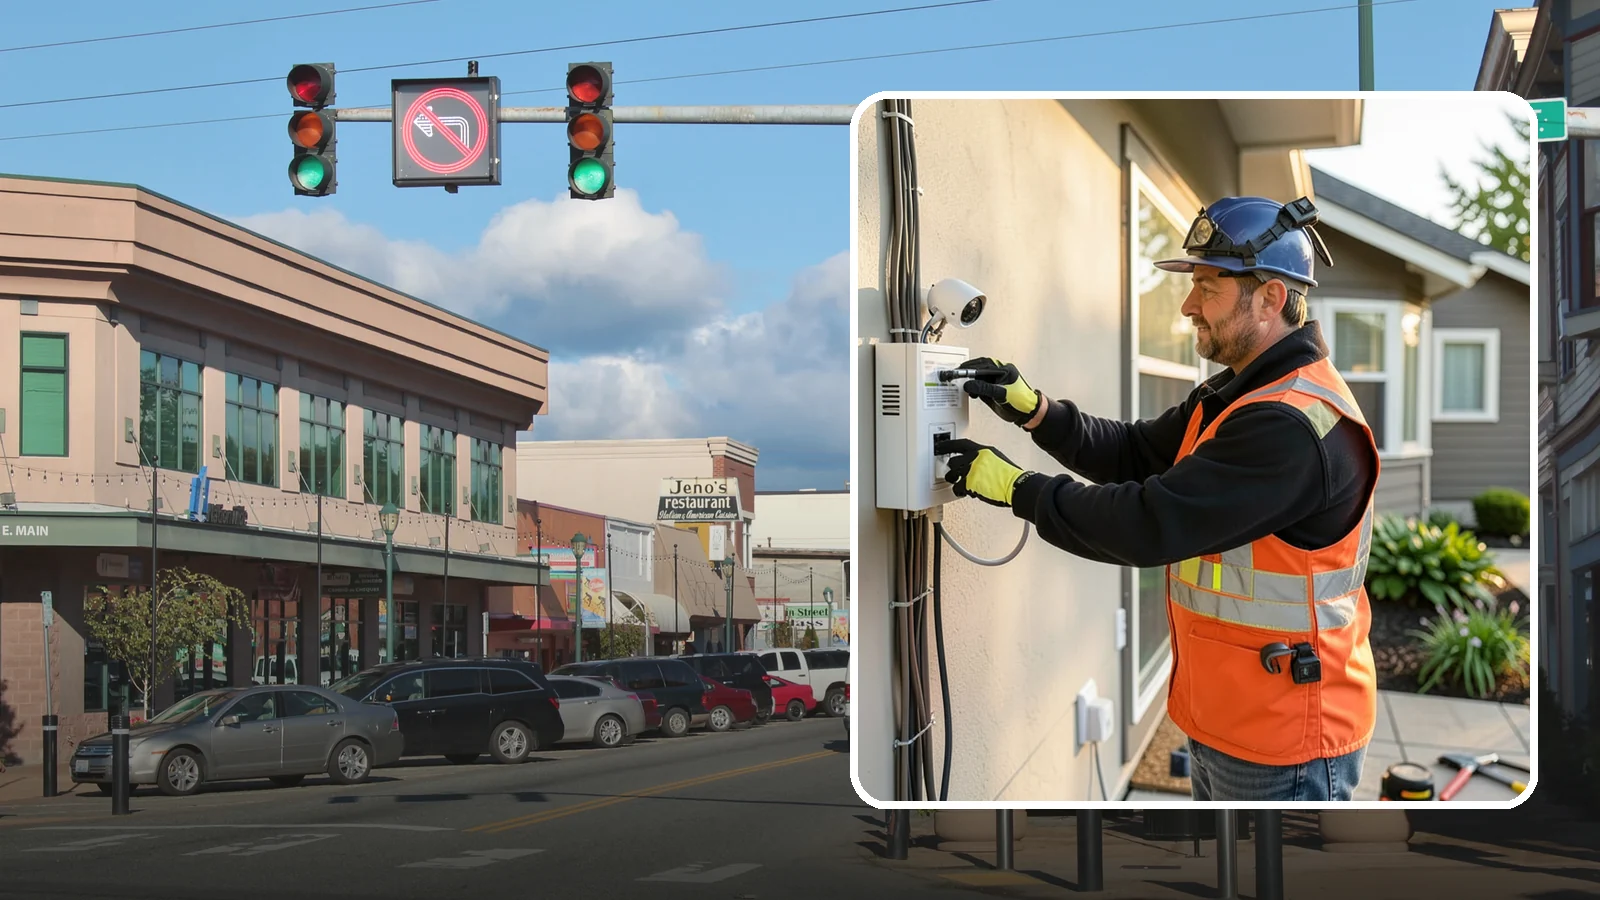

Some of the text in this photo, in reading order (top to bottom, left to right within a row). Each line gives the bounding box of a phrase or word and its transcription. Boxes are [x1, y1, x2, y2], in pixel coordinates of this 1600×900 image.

[669, 480, 727, 494] Jeno's
[665, 496, 731, 509] restaurant
[659, 510, 681, 519] Italian
[686, 509, 714, 519] American
[715, 509, 738, 519] Cuisine
[2, 525, 49, 536] E. MAIN
[797, 607, 829, 617] Street
